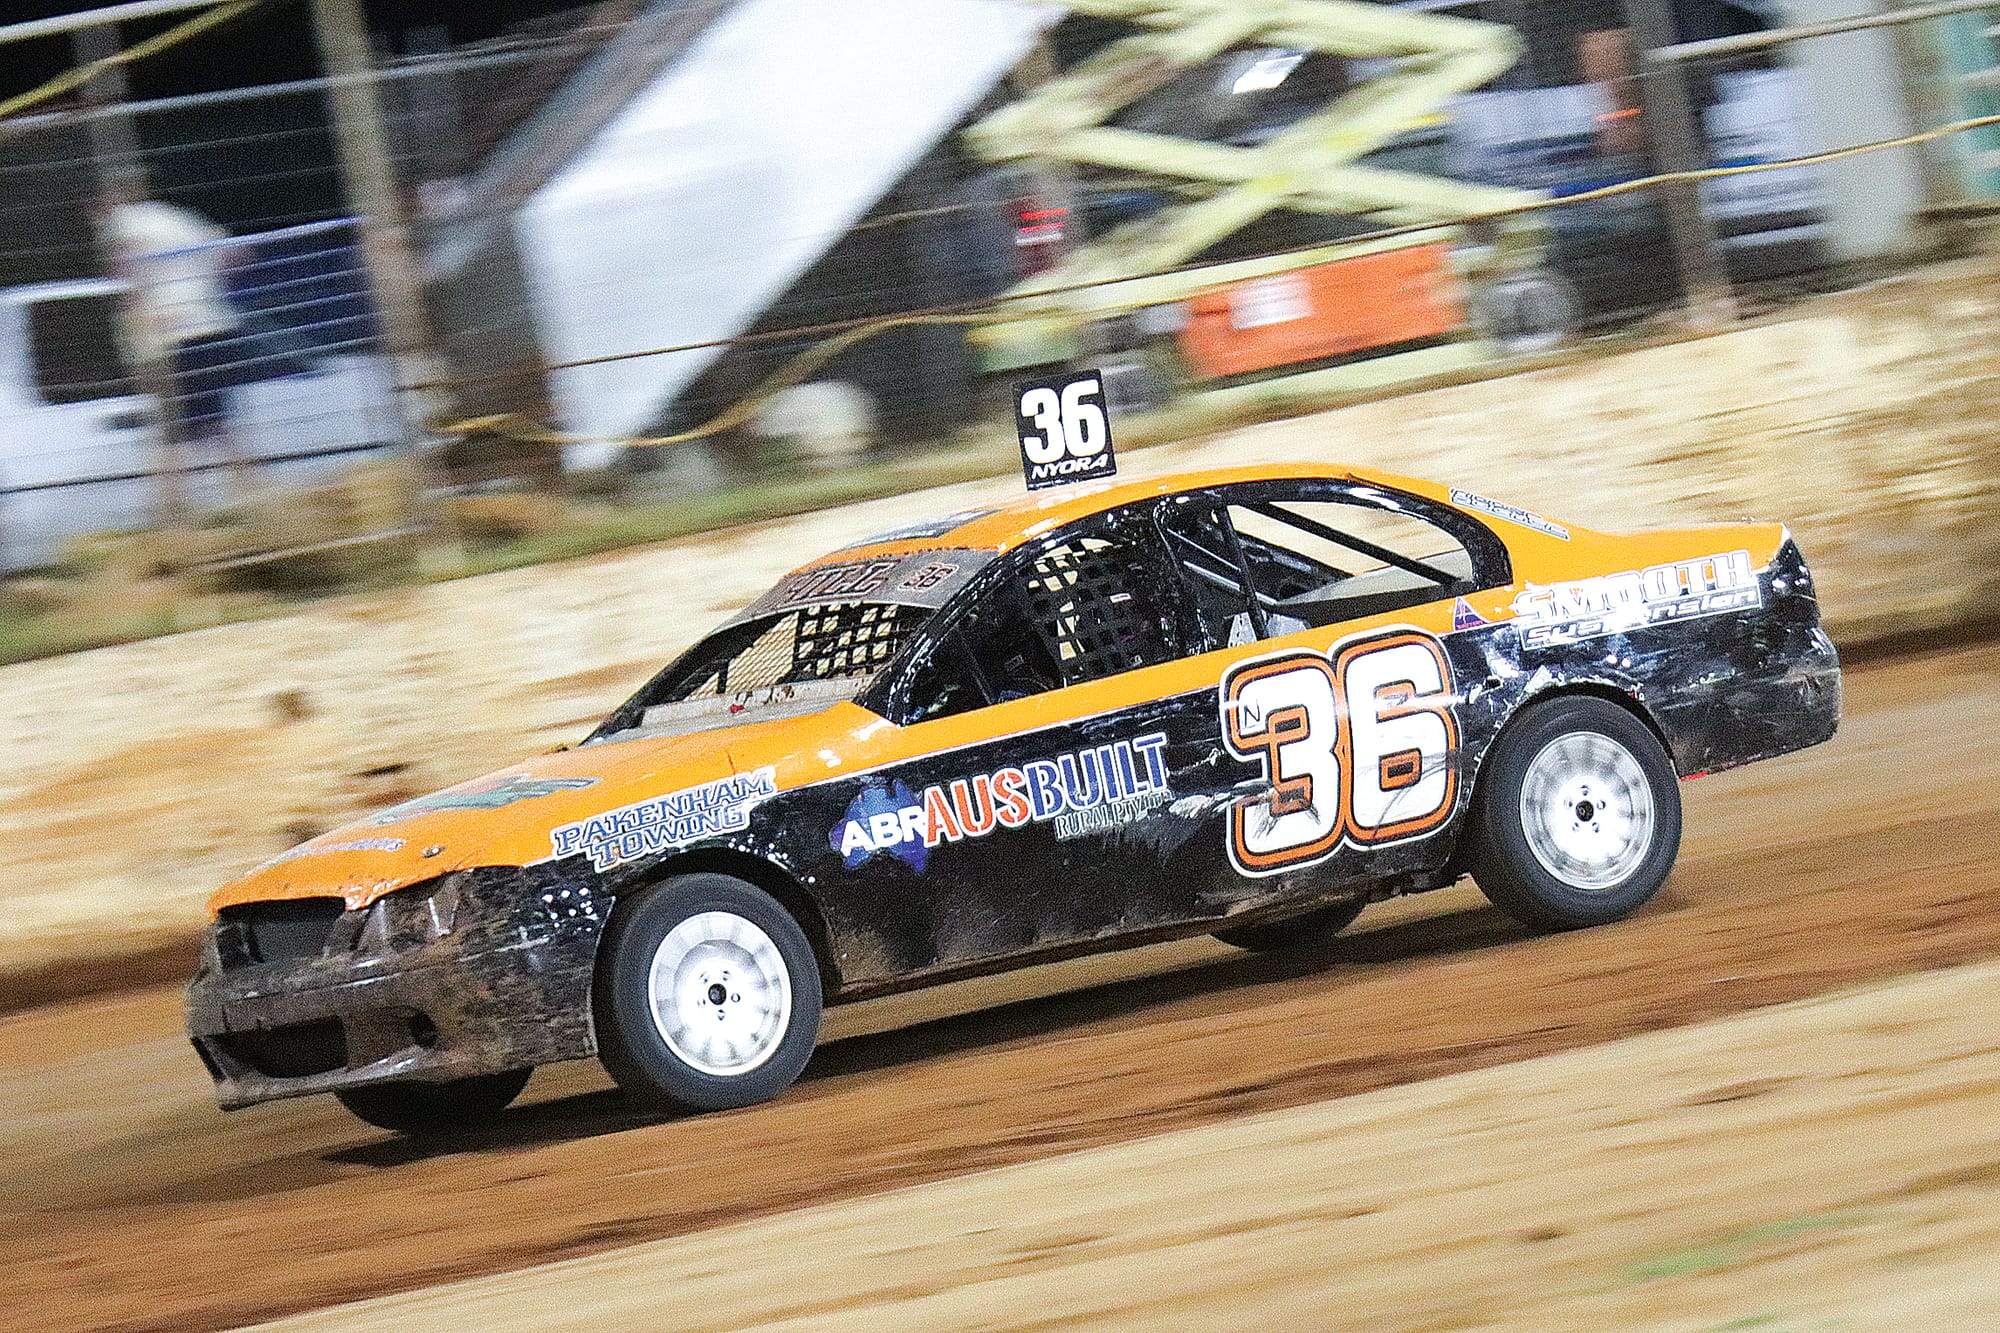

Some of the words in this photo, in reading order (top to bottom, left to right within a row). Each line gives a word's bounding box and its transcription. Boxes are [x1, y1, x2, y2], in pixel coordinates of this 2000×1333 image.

[1021, 380, 1106, 464] 36
[1031, 453, 1109, 480] NYORA
[899, 562, 959, 592] 36
[1514, 550, 1752, 620] SMOOTH
[1219, 624, 1463, 878] 36
[555, 771, 774, 857] PAKENHAM
[922, 731, 1167, 847] AUSBUILT
[1056, 803, 1112, 838] RURAL
[591, 804, 744, 869] TOWING
